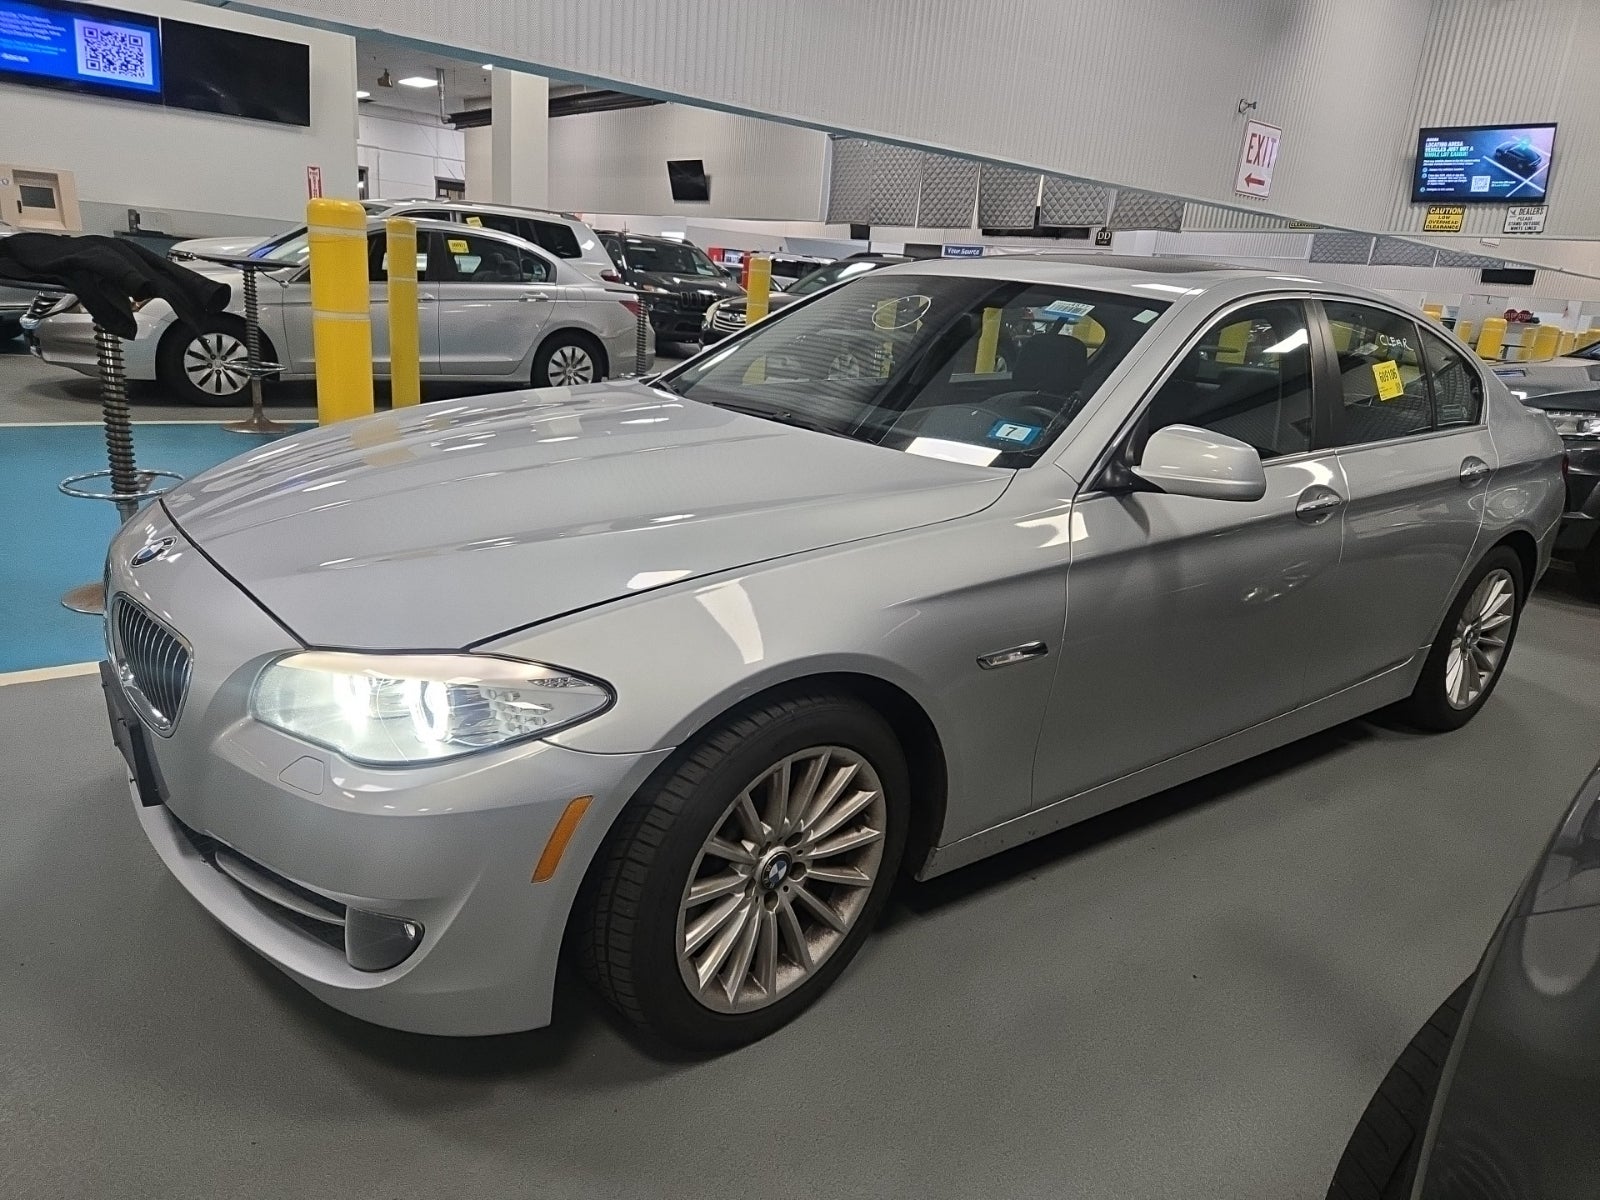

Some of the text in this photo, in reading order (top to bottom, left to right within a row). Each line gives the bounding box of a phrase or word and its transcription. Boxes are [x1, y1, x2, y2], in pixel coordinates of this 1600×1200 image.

[1246, 132, 1277, 168] EXIT
[1429, 207, 1463, 215] CAUTION
[1518, 207, 1544, 215] DEALERS
[1097, 231, 1111, 240] DD
[947, 247, 980, 256] Your Source
[1380, 334, 1414, 351] CLEAR
[1005, 426, 1018, 436] 7
